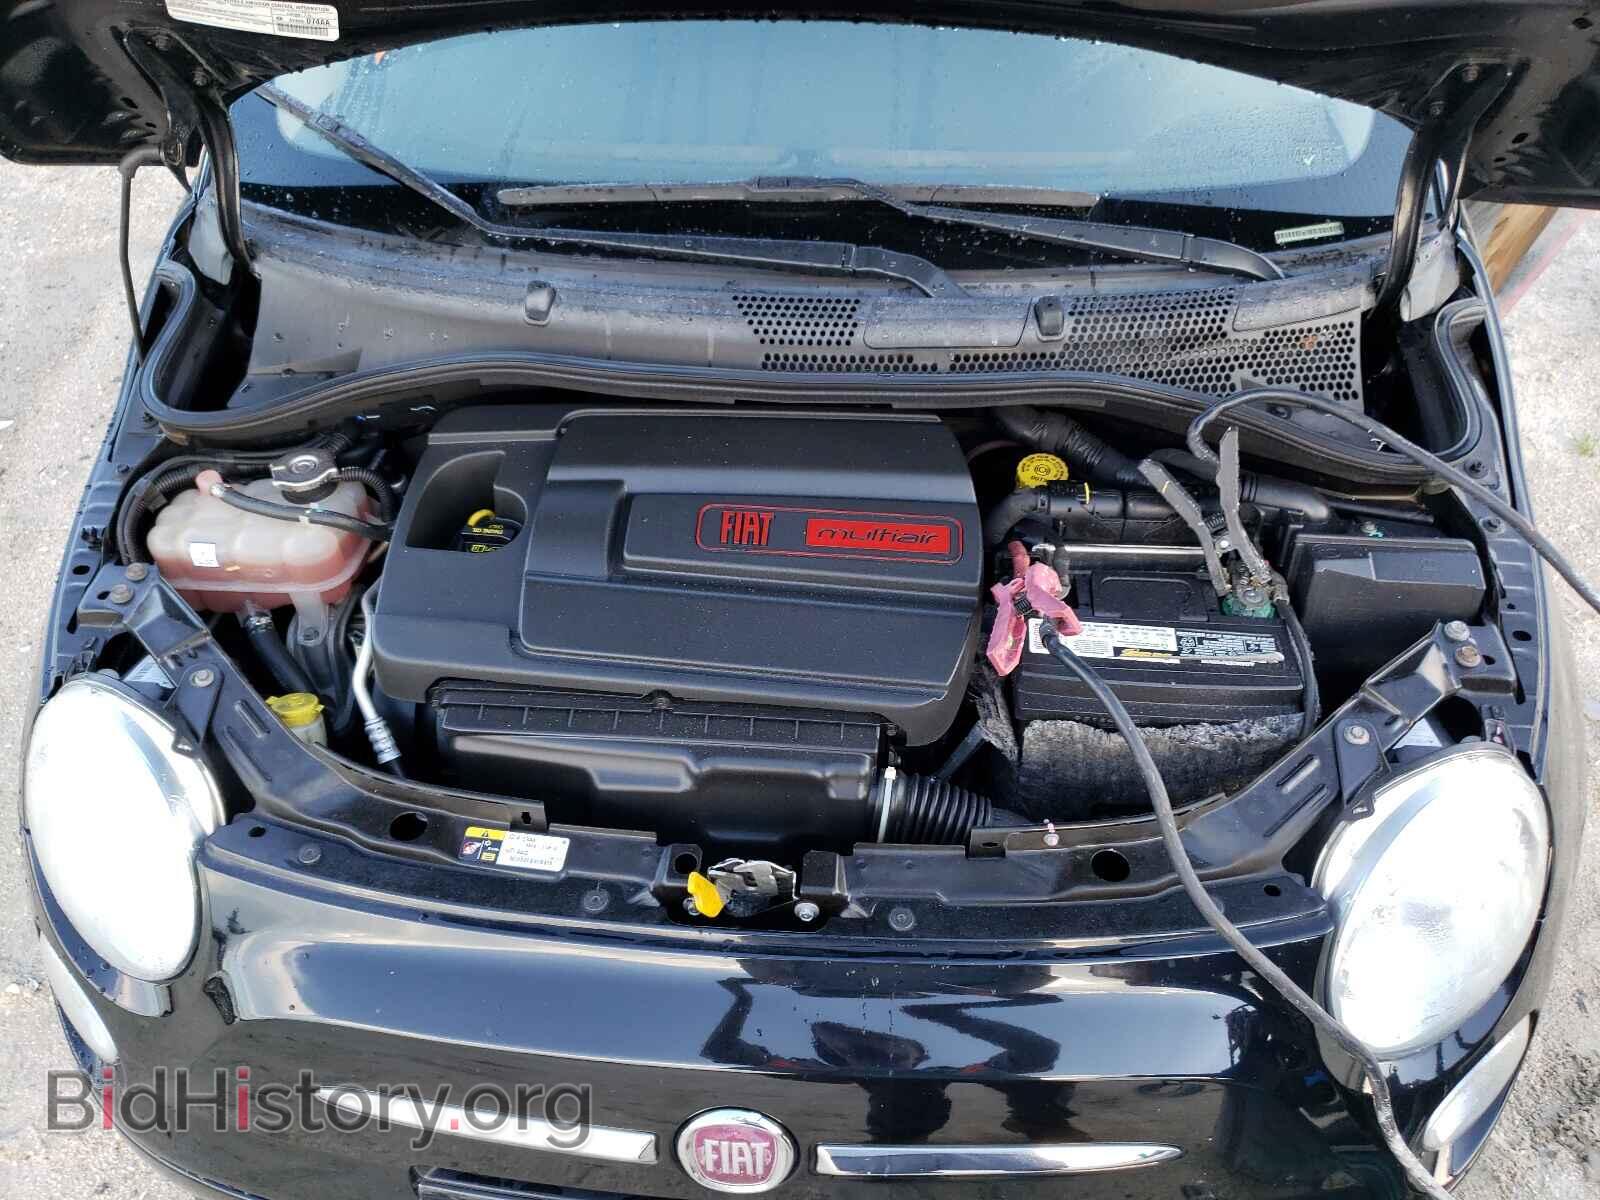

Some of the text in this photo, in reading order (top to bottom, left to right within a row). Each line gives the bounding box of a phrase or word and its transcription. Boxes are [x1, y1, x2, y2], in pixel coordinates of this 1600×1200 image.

[720, 511, 939, 546] FIAT multiair
[703, 1138, 771, 1176] FIAT
